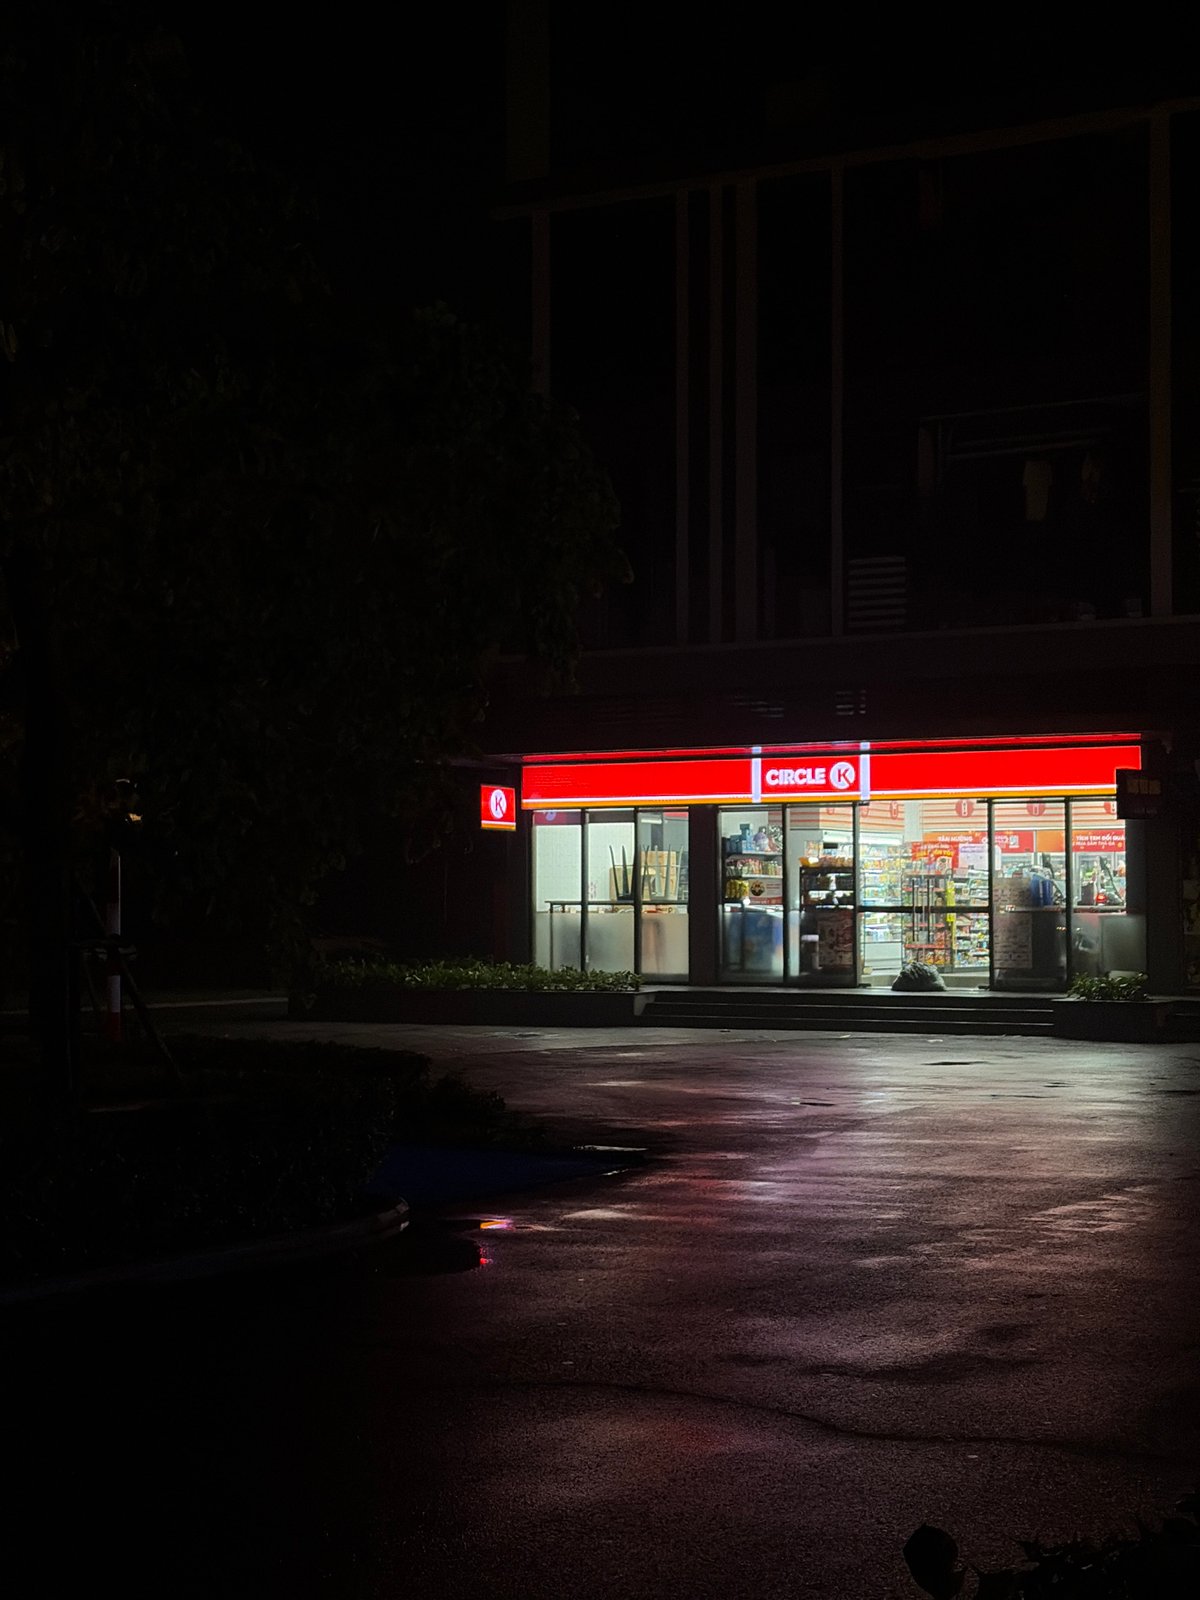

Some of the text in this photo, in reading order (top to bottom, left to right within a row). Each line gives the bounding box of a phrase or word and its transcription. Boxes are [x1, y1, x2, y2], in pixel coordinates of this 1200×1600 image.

[766, 763, 855, 788] CIRCLE K
[491, 790, 506, 817] K
